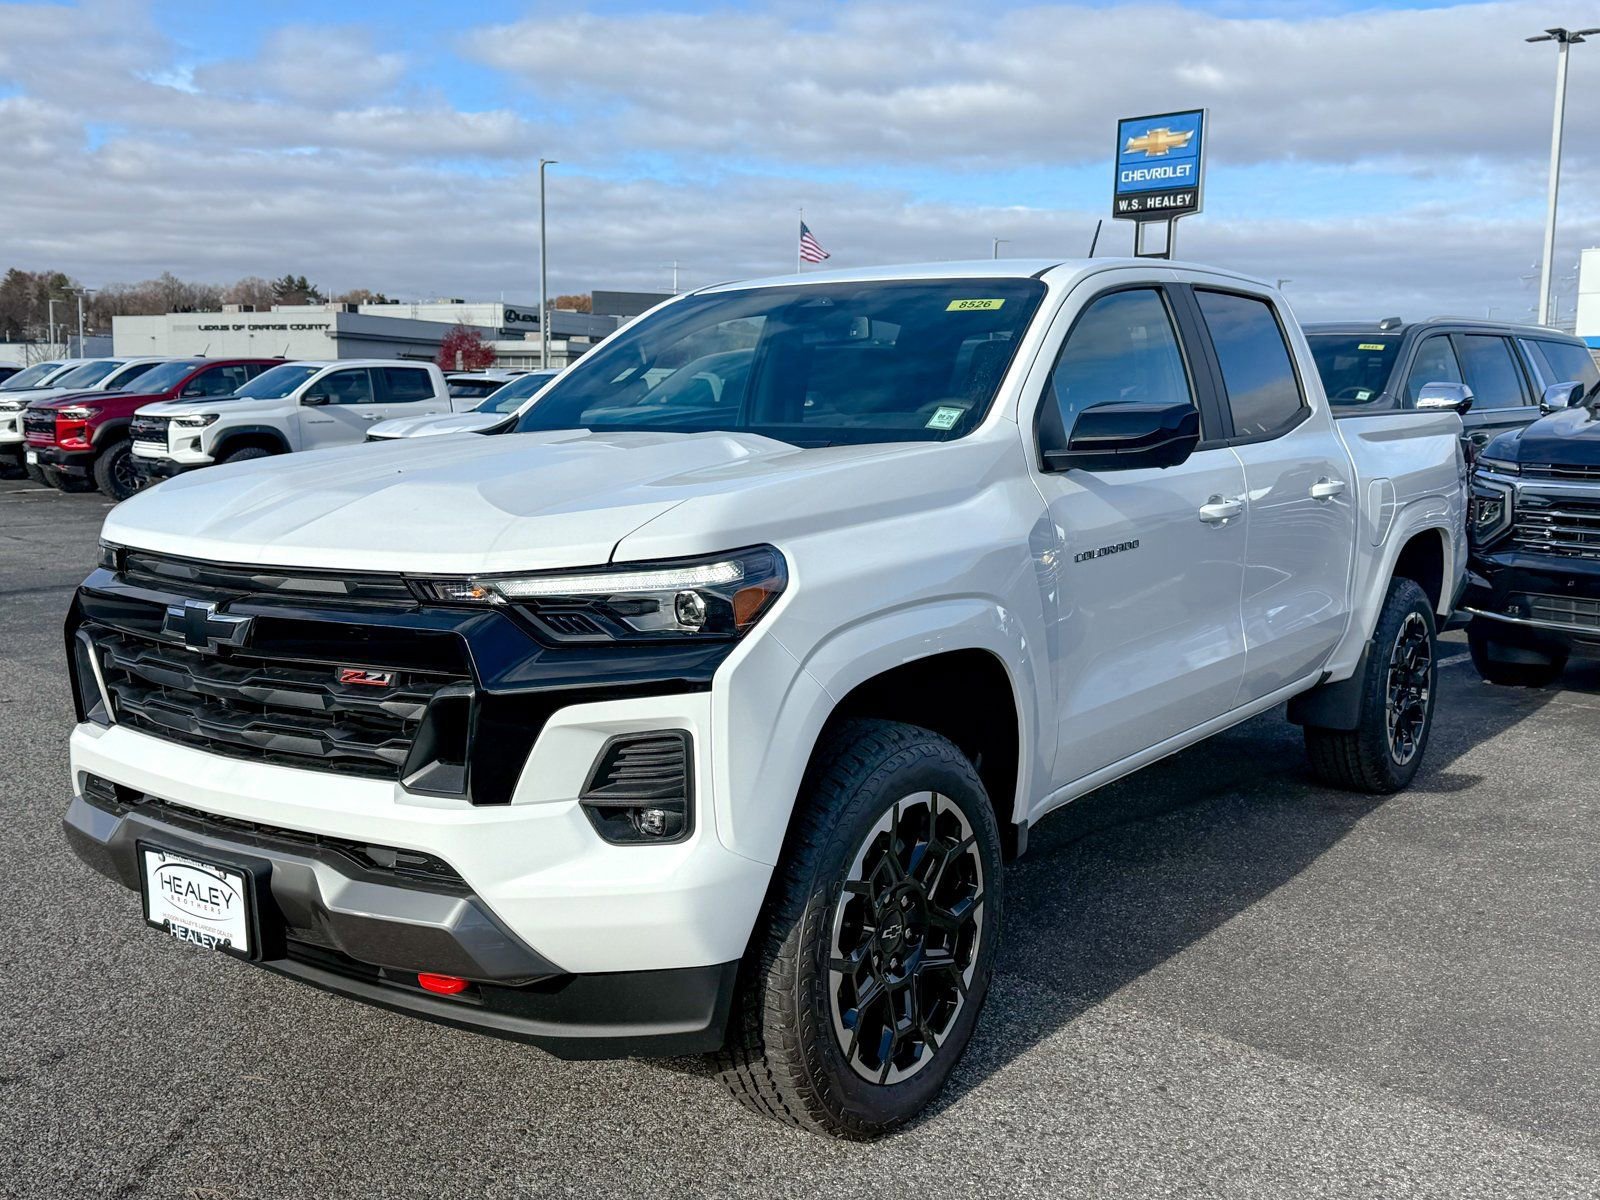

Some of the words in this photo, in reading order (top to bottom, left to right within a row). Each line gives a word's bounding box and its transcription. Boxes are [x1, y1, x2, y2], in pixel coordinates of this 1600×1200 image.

[1121, 164, 1192, 183] CHEVROLET
[1119, 199, 1142, 211] W.S.
[1147, 194, 1192, 208] HEALEY
[958, 301, 992, 309] 8526
[289, 323, 331, 331] COUNTY
[516, 313, 540, 324] LEXU
[1074, 540, 1140, 563] COLORADO
[340, 669, 394, 687] Z71
[159, 872, 233, 909] HEALEY
[171, 894, 221, 915] BROTHERS
[170, 922, 219, 951] HEALEY
